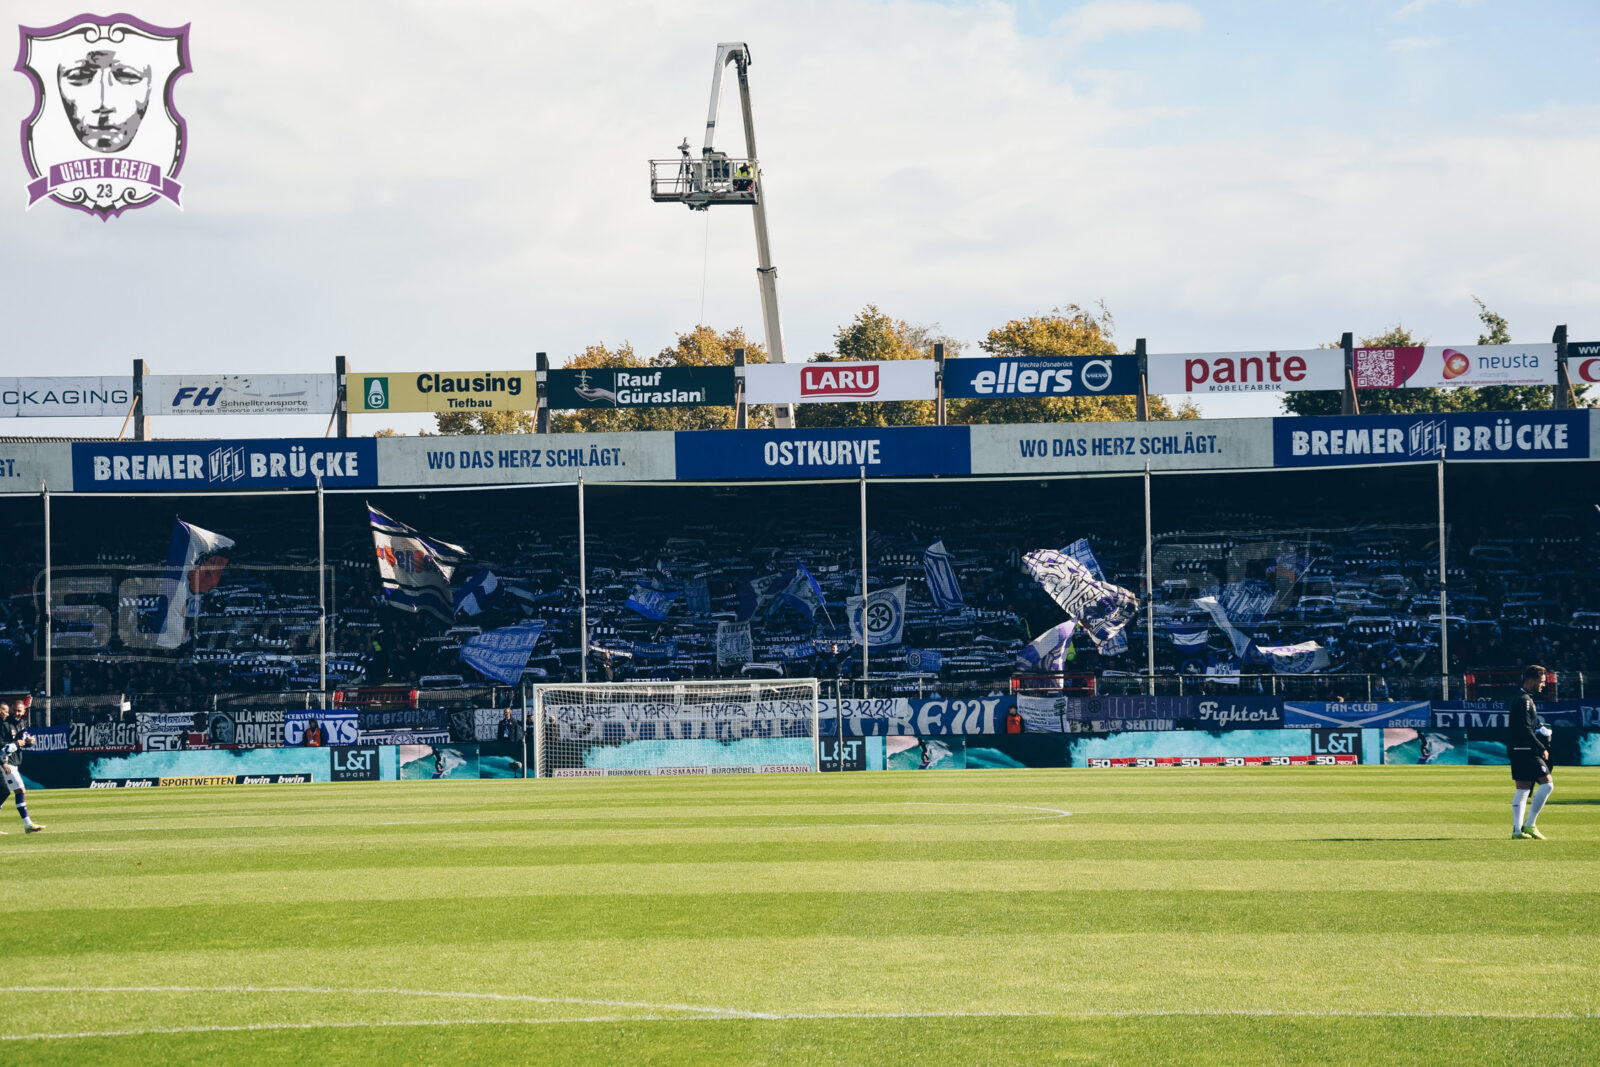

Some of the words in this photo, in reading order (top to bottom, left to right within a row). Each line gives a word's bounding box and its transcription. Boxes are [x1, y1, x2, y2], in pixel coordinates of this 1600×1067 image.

[1478, 353, 1539, 369] neusta
[1185, 351, 1307, 392] pante
[618, 371, 662, 387] Rauf
[806, 370, 875, 390] LARU
[970, 361, 1073, 394] ellers
[416, 373, 522, 396] Clausing
[1209, 384, 1282, 392] MÖBELFABRIK
[2, 390, 128, 405] CKAGING
[172, 386, 223, 407] FH
[616, 388, 701, 404] Güraslan
[220, 399, 308, 409] Schnelltransporte
[447, 398, 493, 408] Tiefbau
[1292, 428, 1404, 456] BREMER
[1453, 418, 1569, 452] BRÜCKE
[1020, 439, 1048, 458] WO
[1053, 438, 1087, 457] DAS
[1091, 437, 1136, 456] HERZ
[1140, 432, 1222, 455] SCHLÄGT.
[427, 451, 455, 470] WO
[459, 451, 494, 469] DAS
[498, 450, 542, 469] HERZ
[546, 444, 626, 468] SCHLÄGT.
[764, 439, 881, 466] OSTKURVE
[93, 454, 204, 481] BREMER
[250, 445, 359, 478] BRÜCKE
[1326, 703, 1378, 713] FAN-CLUB
[235, 710, 285, 723] LILA-WEISSE
[1199, 701, 1280, 727] Fighters
[1126, 719, 1174, 730] SEKTION
[1388, 718, 1427, 728] BRÜCKE
[235, 723, 285, 745] ARMEE
[1314, 732, 1358, 754] L&T
[334, 750, 376, 770] L&T
[1091, 760, 1111, 768] SO
[1136, 759, 1156, 767] SO
[1181, 759, 1201, 767] SO
[1225, 758, 1245, 766] SO
[1270, 757, 1290, 765] SO
[1316, 756, 1335, 765] SO
[556, 770, 601, 778] ASSMANN
[660, 768, 704, 776] ASSMANN
[764, 766, 808, 774] ASSMANN
[89, 780, 117, 789] bwin
[125, 778, 153, 788] bwin
[161, 776, 234, 787] SPORTWETTEN
[243, 776, 271, 785] bwin
[278, 775, 305, 784] bwin
